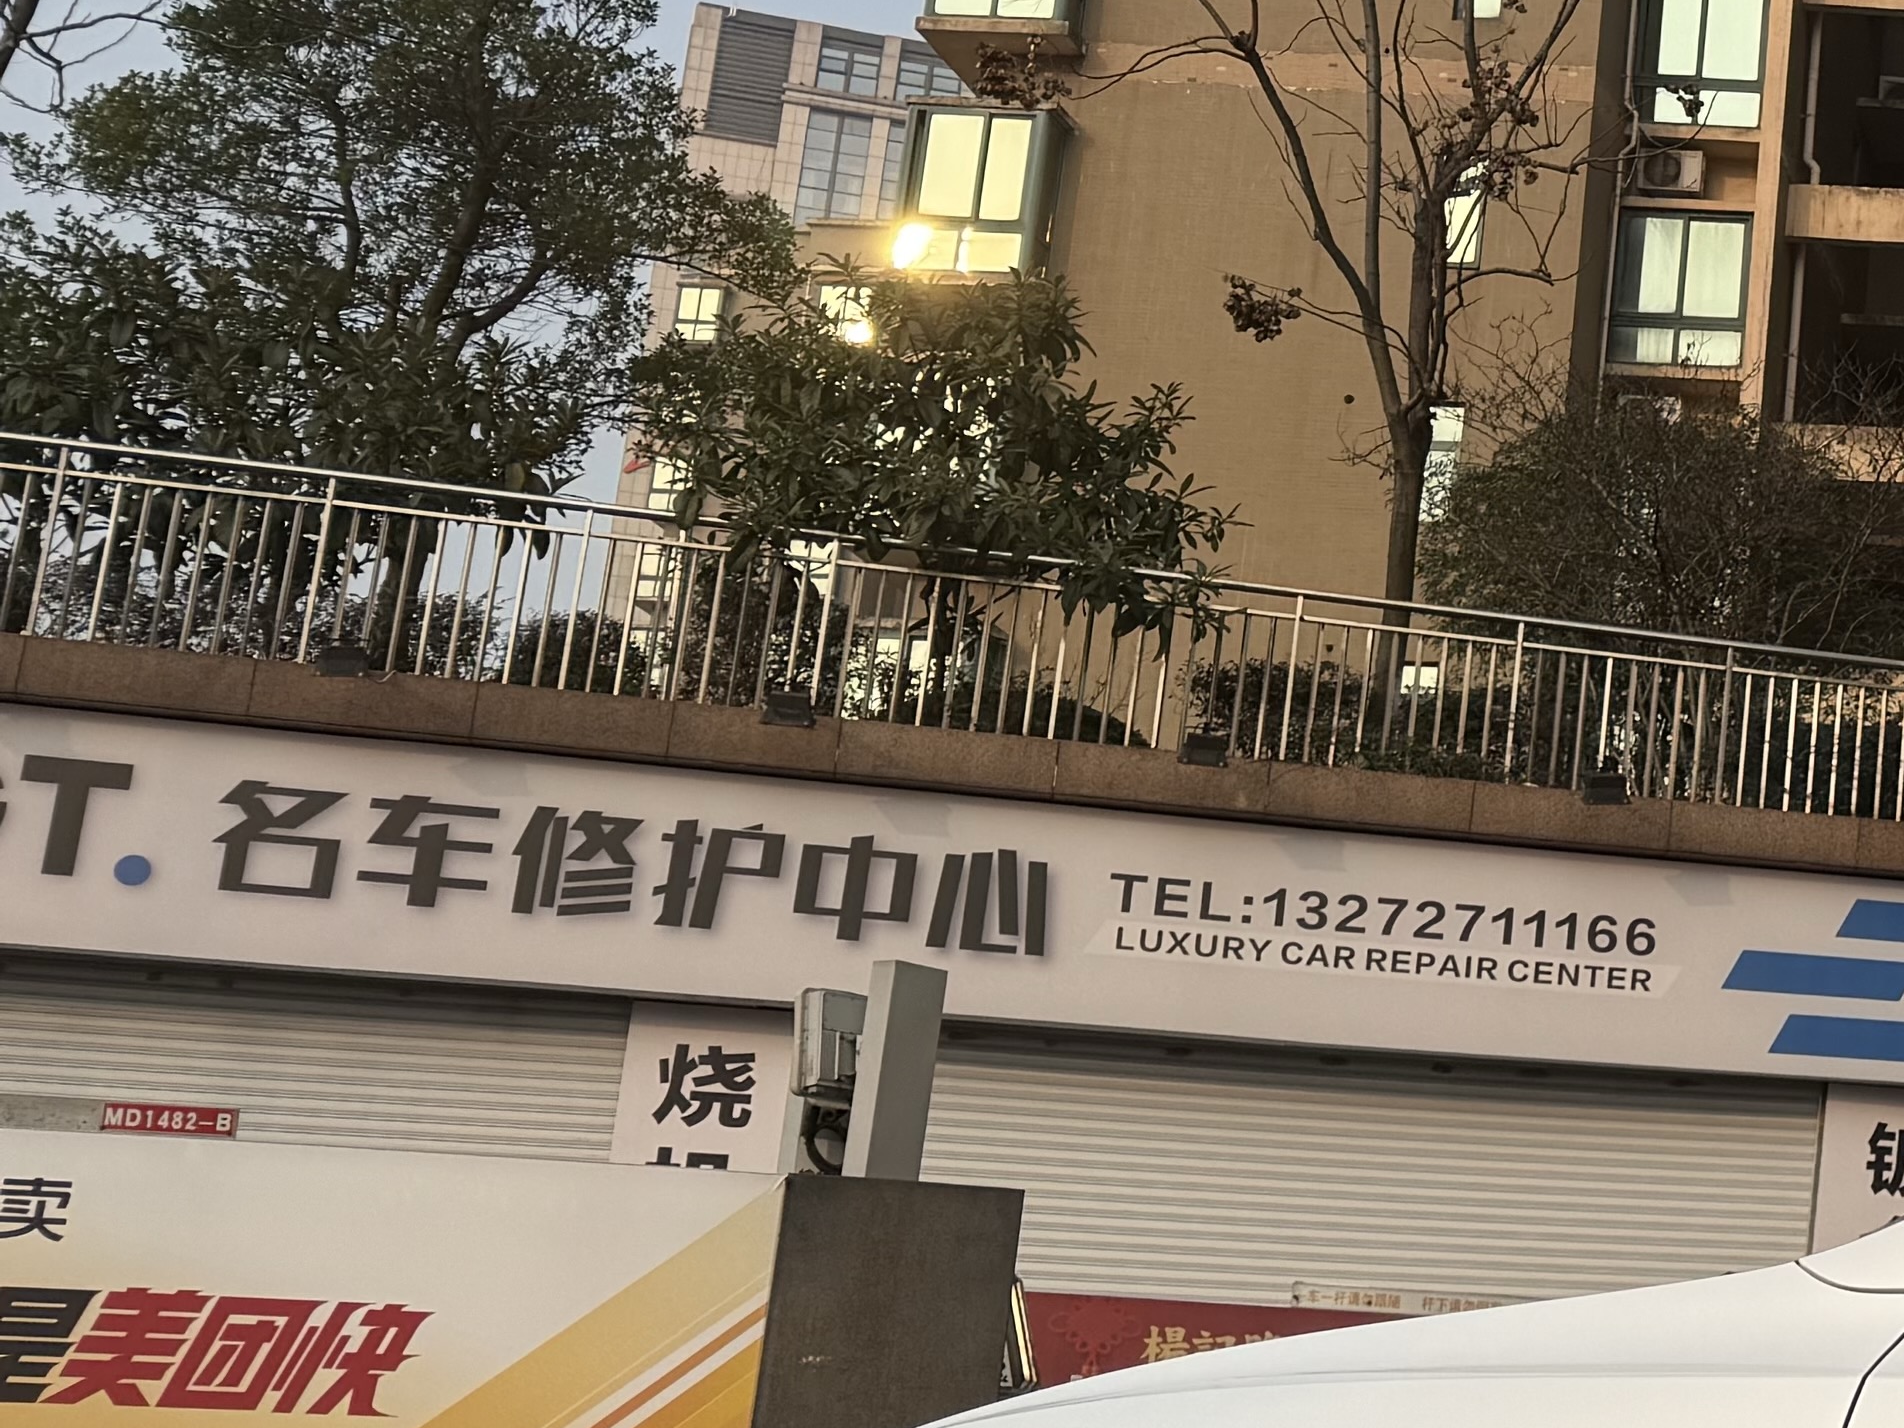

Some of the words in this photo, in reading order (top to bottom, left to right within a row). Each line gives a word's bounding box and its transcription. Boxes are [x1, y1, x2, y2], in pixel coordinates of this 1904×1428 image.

[0, 754, 152, 886] T.
[212, 779, 1048, 956] 名车修护中心
[1110, 873, 1656, 956] TEL:13272711166
[1115, 926, 1272, 962] LUXURY
[1281, 941, 1355, 970] CAR
[1365, 948, 1498, 980] REPAIR
[1507, 959, 1652, 992] CENTER
[103, 1107, 232, 1132] MD1482-B
[0, 1177, 73, 1242] 卖
